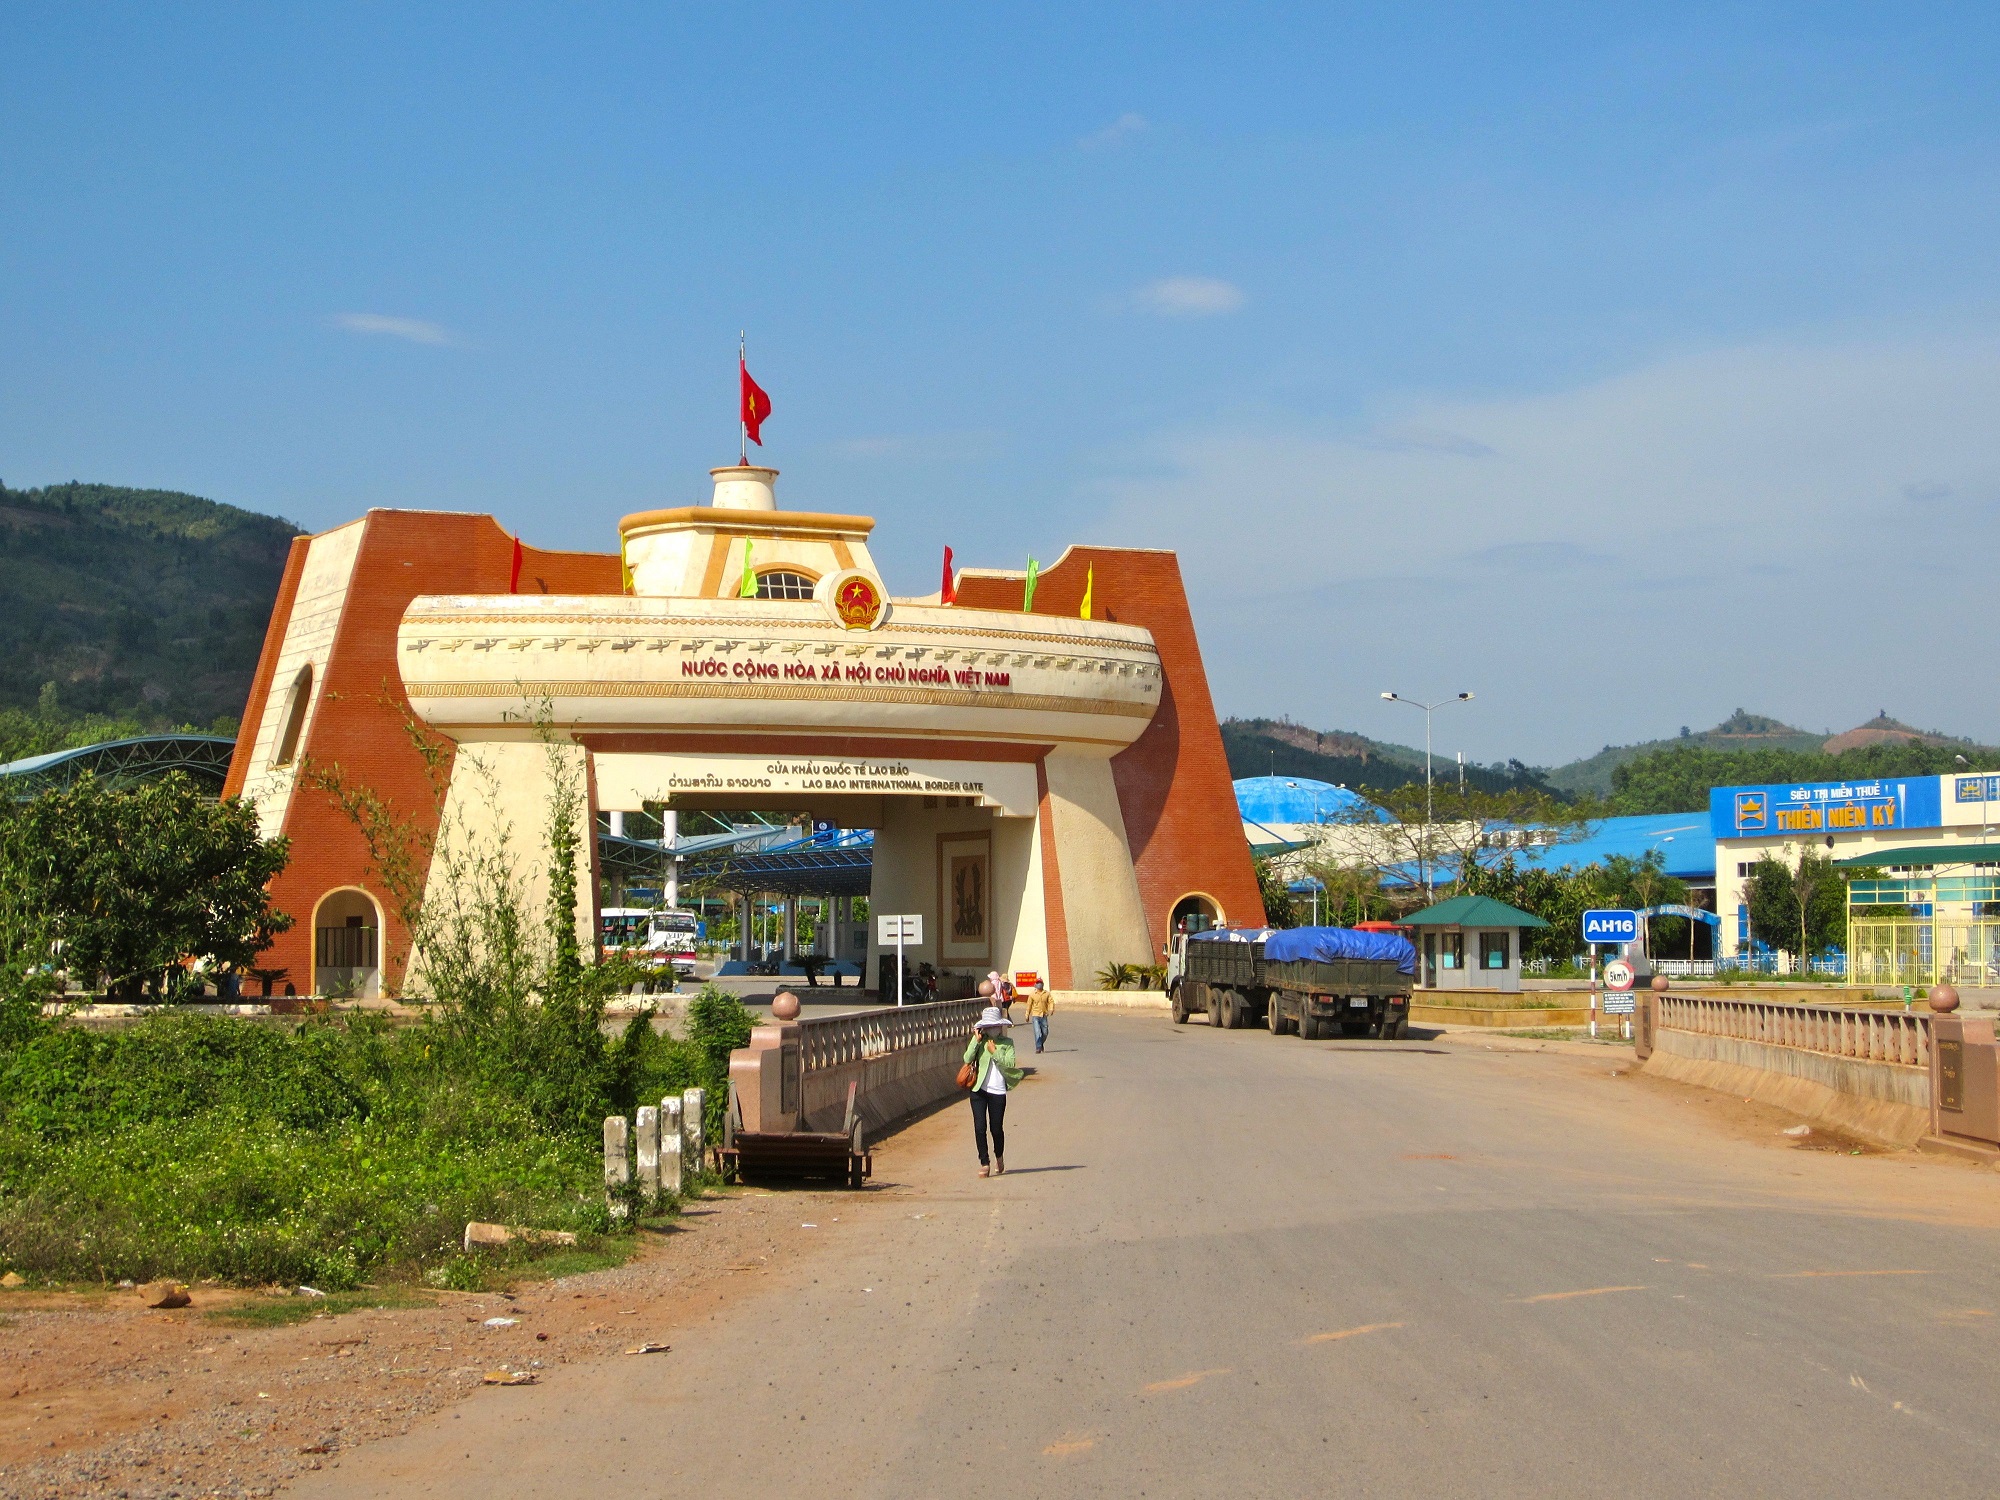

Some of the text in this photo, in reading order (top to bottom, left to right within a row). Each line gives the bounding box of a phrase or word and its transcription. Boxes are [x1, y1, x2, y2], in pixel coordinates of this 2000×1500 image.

[681, 657, 1010, 688] NƯỚC CỘNG HÒA XÃ HỘI CHỦ NGHĨA VIỆT NAM
[766, 760, 789, 774] CỬA
[822, 761, 851, 775] QUỐC
[854, 760, 867, 775] TẾ
[868, 765, 888, 775] LAO
[889, 762, 909, 776] BẢO
[802, 779, 984, 791] LAO BAO INTERNATIONAL BORDER GATE
[1790, 780, 1880, 800] SIÊU THỊ MIỄN THUẾ
[1776, 798, 1896, 830] THIÊN NIÊN KỶ
[1587, 919, 1634, 933] AH16
[1609, 970, 1628, 982] 5km/h
